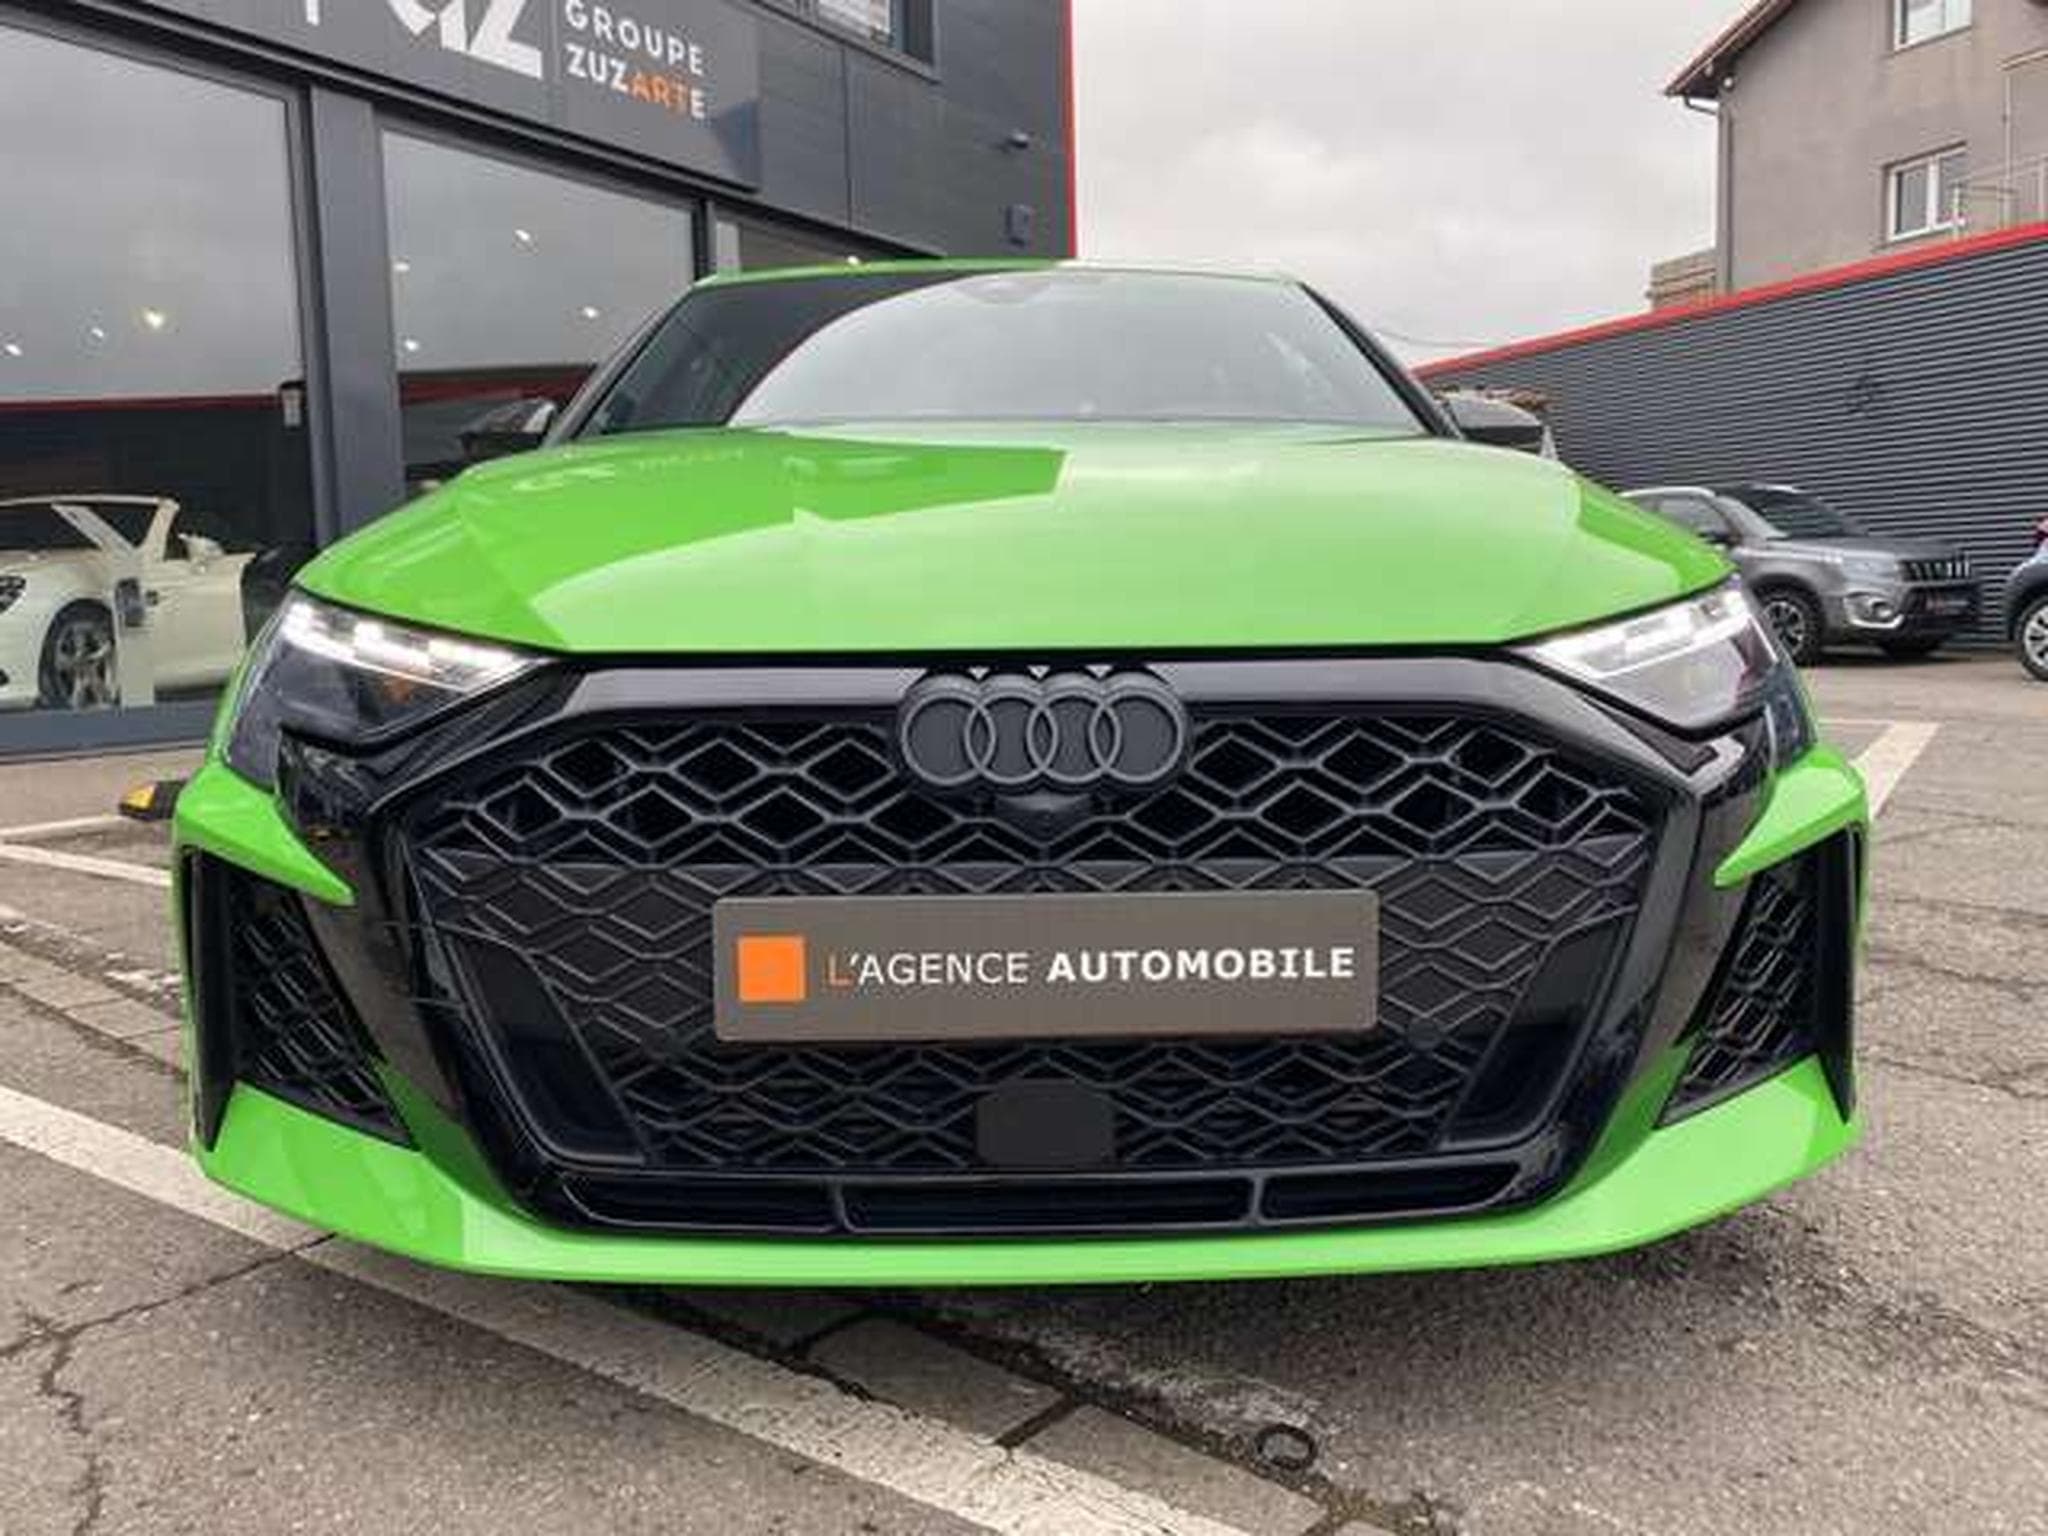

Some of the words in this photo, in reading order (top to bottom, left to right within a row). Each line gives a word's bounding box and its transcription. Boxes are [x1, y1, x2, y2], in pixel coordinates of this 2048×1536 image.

[565, 0, 703, 76] GROUPE
[565, 43, 705, 119] ZUZARTE
[828, 952, 1028, 986] L'AGENCE
[1047, 947, 1355, 983] AUTOMOBILE
